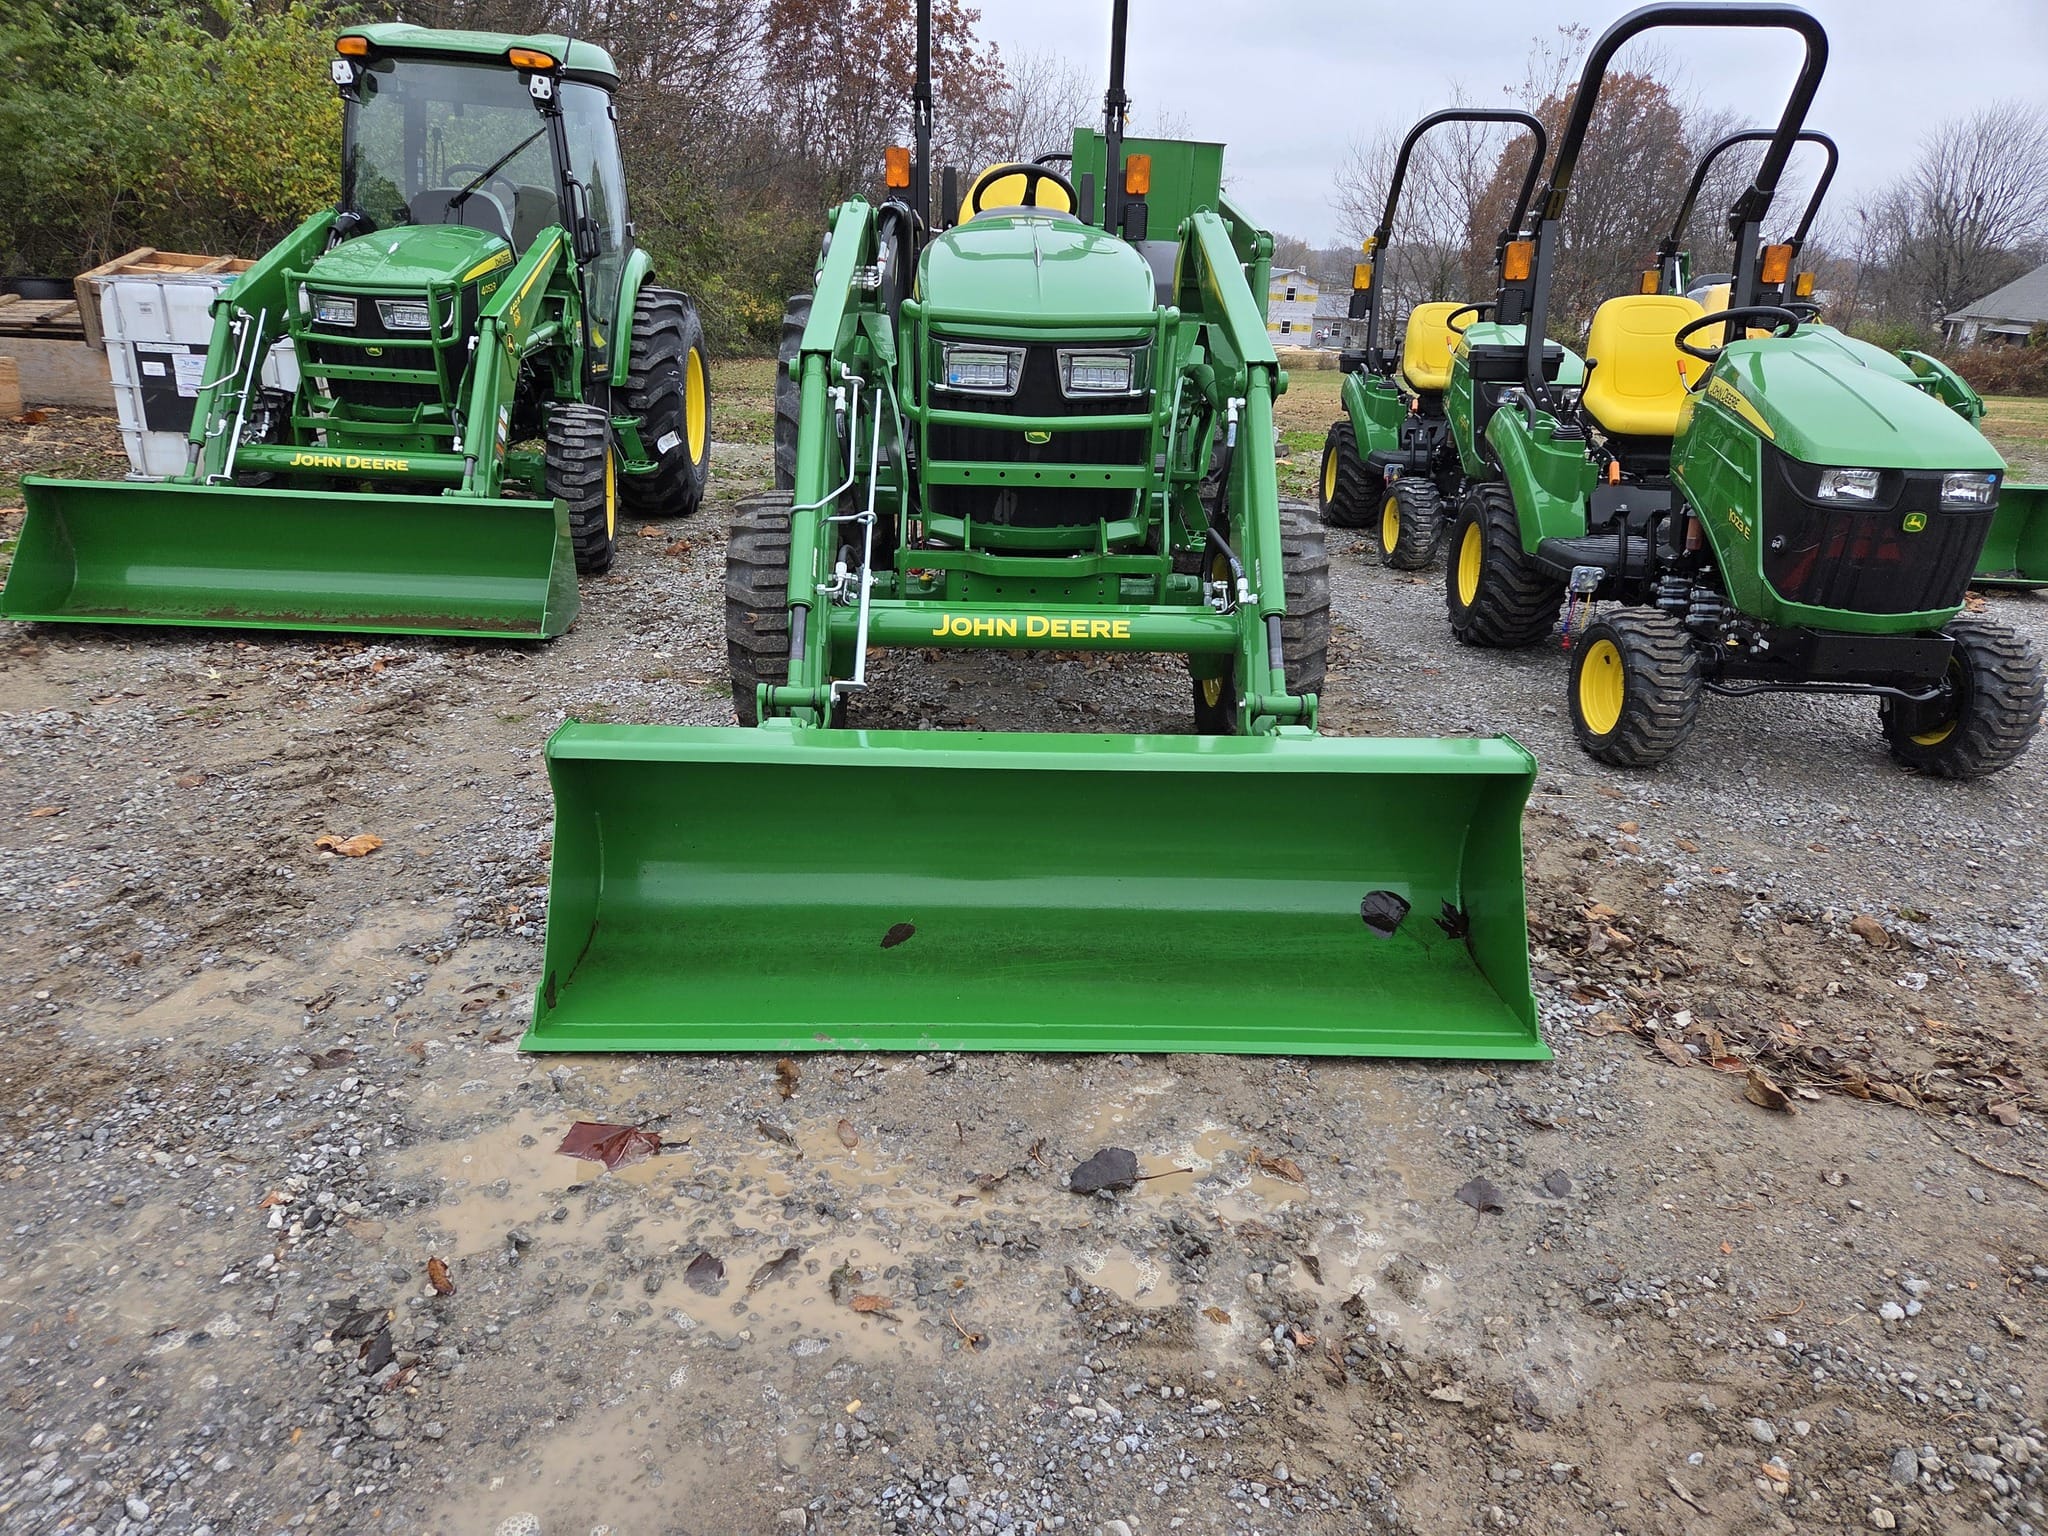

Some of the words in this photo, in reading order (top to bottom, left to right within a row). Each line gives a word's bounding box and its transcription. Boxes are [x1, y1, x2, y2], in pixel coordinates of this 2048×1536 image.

[1710, 385, 1724, 401] JOHN
[1722, 388, 1741, 410] DEERE
[290, 453, 342, 468] JOHN
[346, 455, 409, 471] DEERE
[1728, 507, 1744, 532] 1023
[1744, 526, 1751, 540] E
[933, 614, 1018, 638] JOHN
[1026, 615, 1131, 639] DEERE
